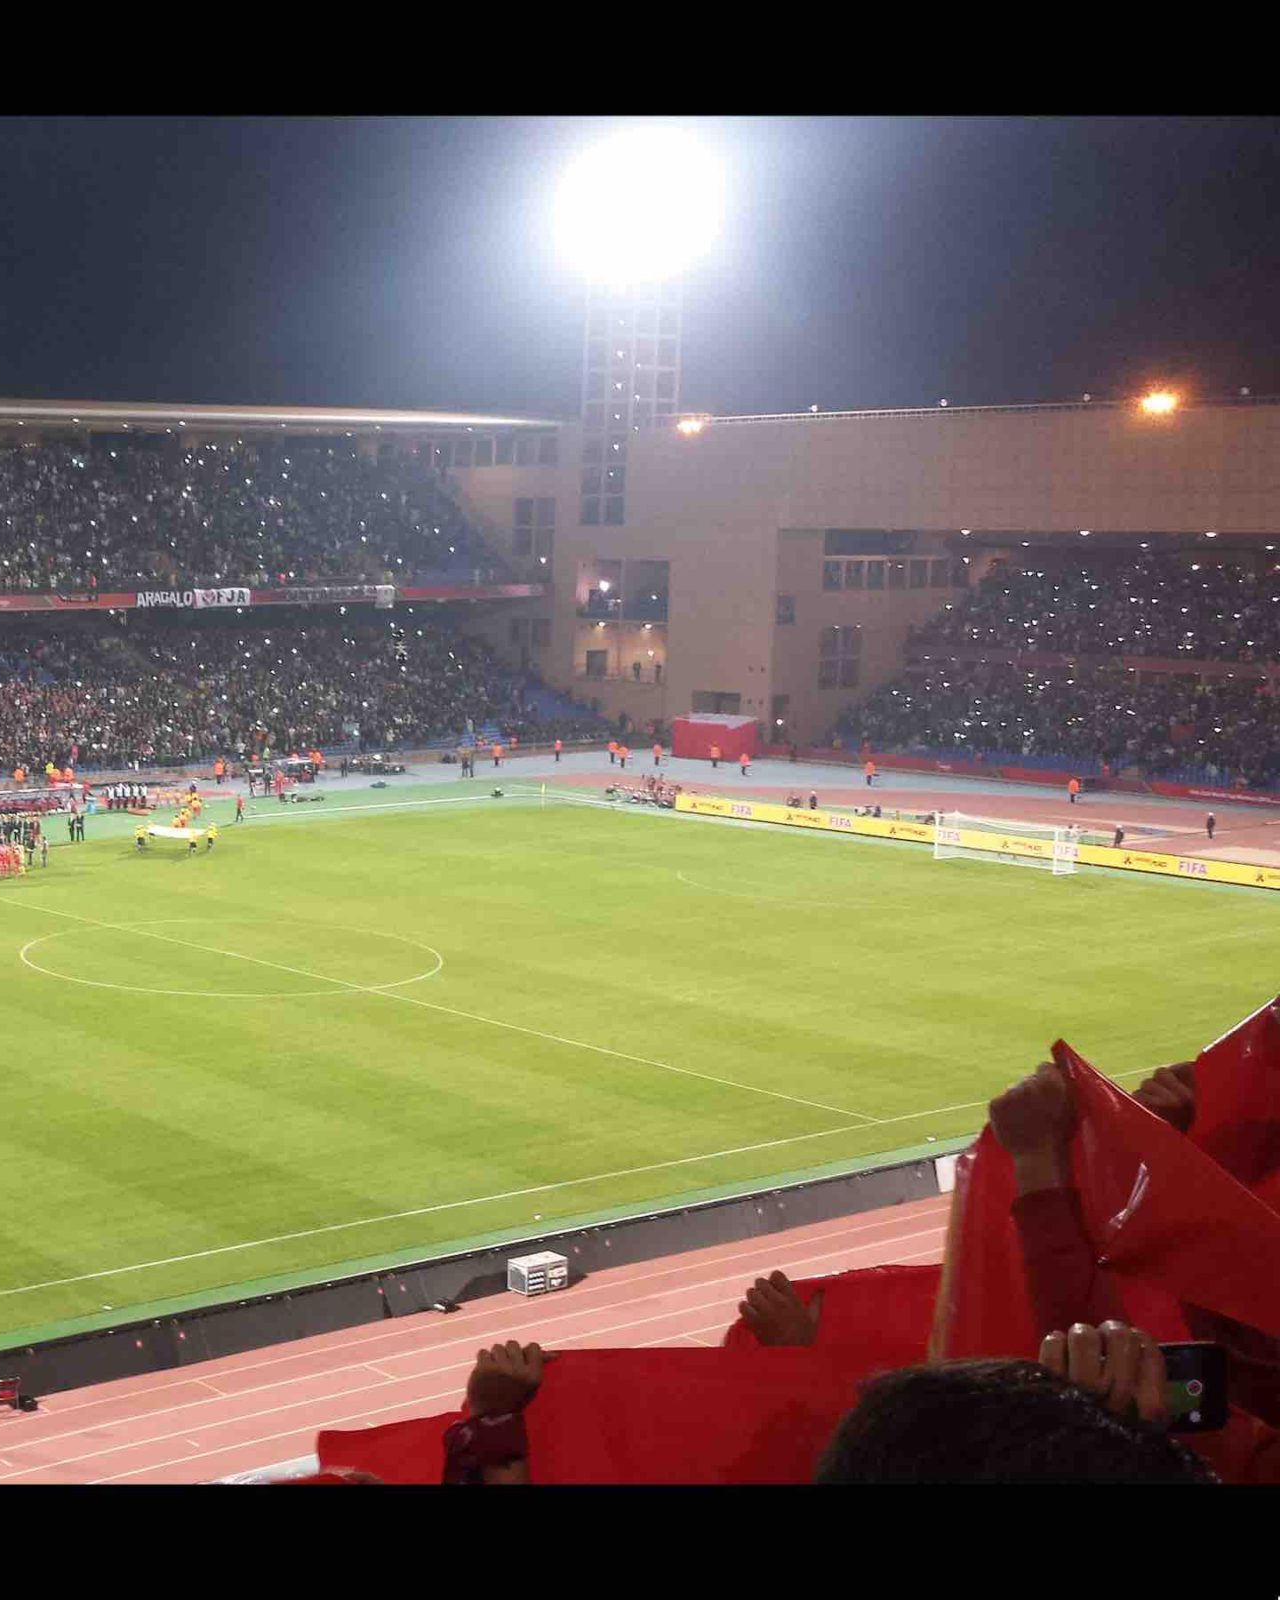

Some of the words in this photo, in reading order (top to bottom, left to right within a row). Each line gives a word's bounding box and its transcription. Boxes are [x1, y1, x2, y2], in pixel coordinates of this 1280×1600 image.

[136, 590, 193, 608] ARAGALO
[830, 816, 851, 829] FIFA
[1179, 860, 1208, 875] FIFA
